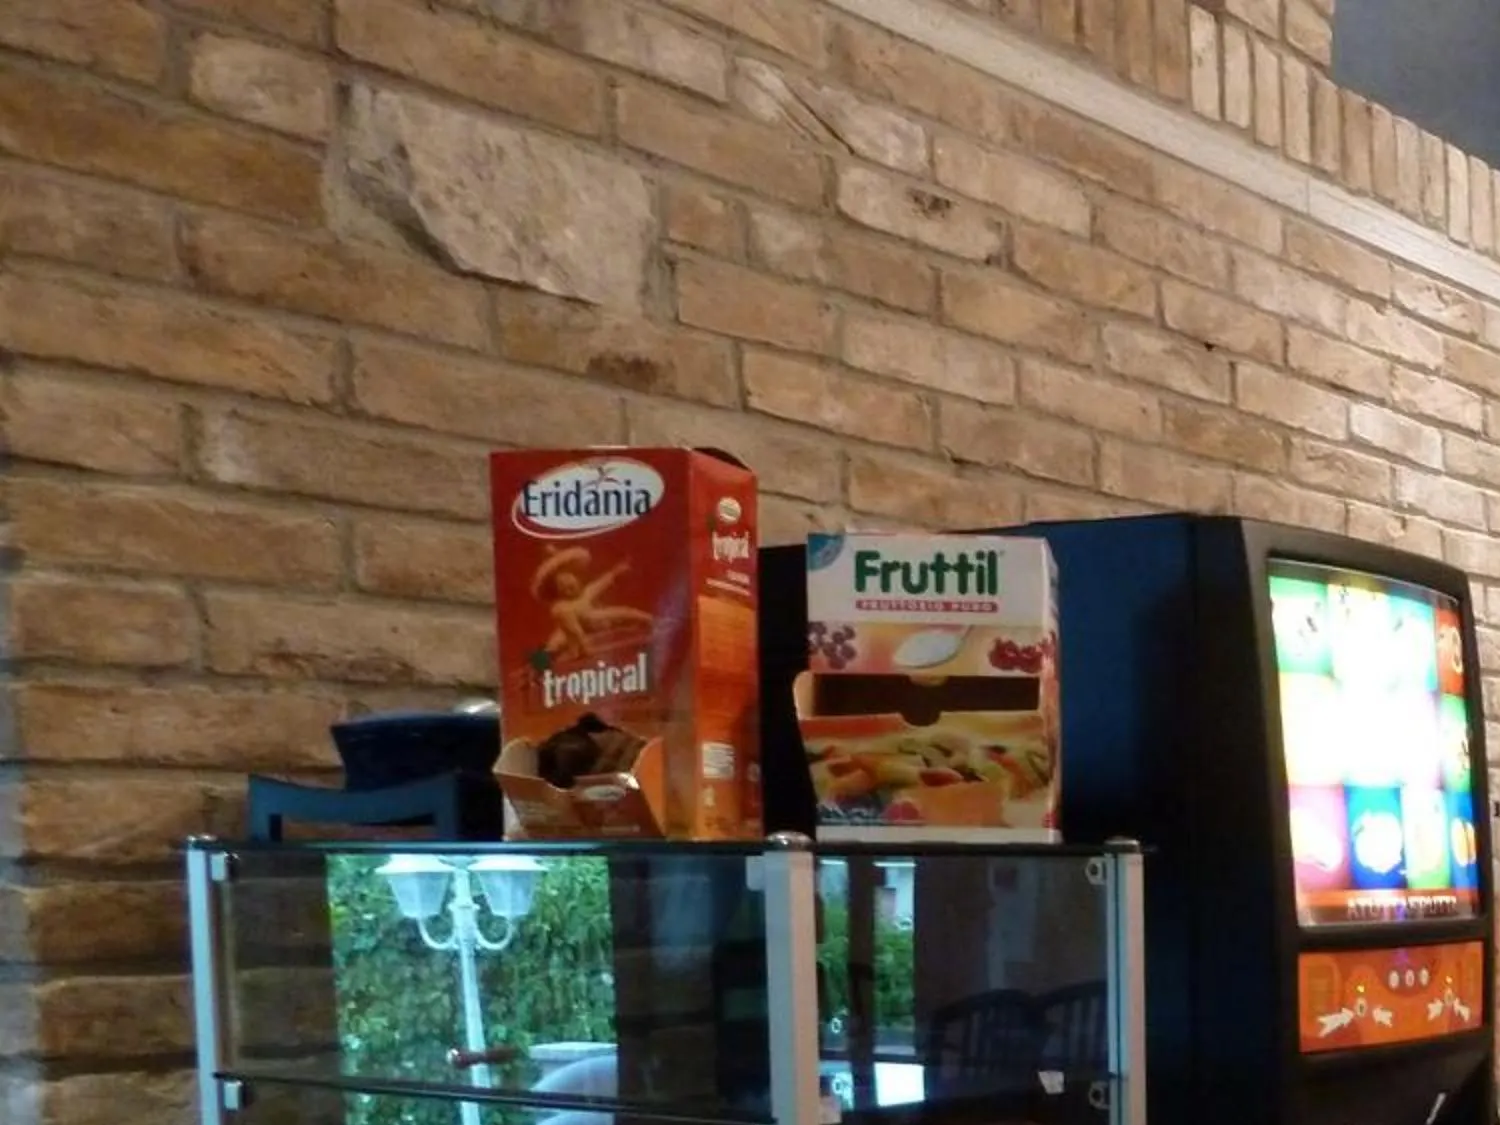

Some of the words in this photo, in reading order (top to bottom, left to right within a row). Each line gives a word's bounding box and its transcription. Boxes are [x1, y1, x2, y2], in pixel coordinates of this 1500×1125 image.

[522, 478, 651, 518] Eridania
[855, 549, 998, 595] Fruttil
[544, 652, 647, 708] tropical
